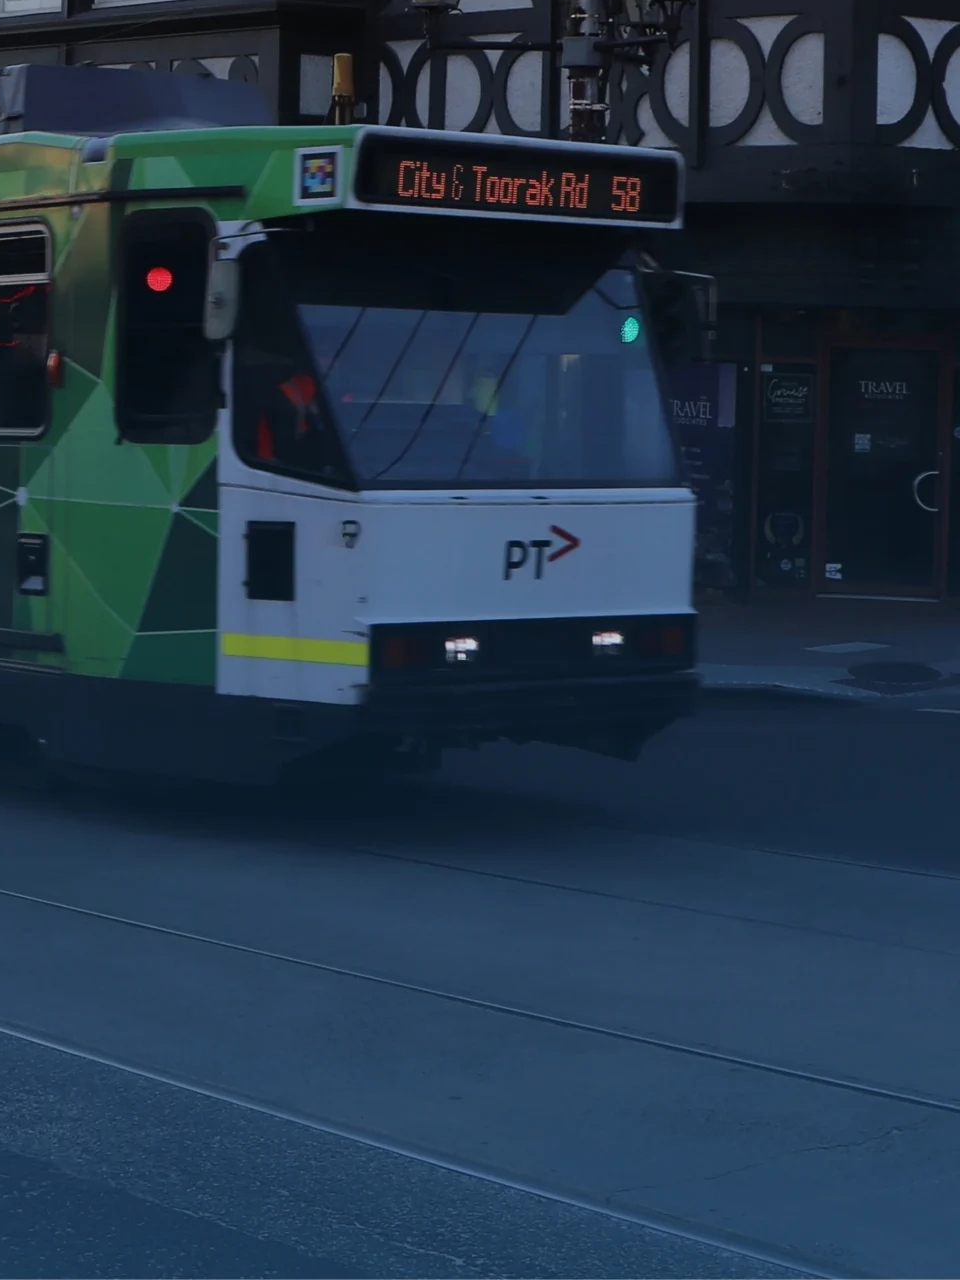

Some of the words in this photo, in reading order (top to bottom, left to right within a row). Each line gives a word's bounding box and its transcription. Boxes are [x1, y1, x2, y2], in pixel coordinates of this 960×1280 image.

[398, 160, 446, 200] City
[451, 164, 464, 201] &
[472, 165, 555, 207] Toorak
[559, 172, 590, 209] Rd
[611, 176, 641, 212] 58
[858, 380, 911, 395] TRAVEL
